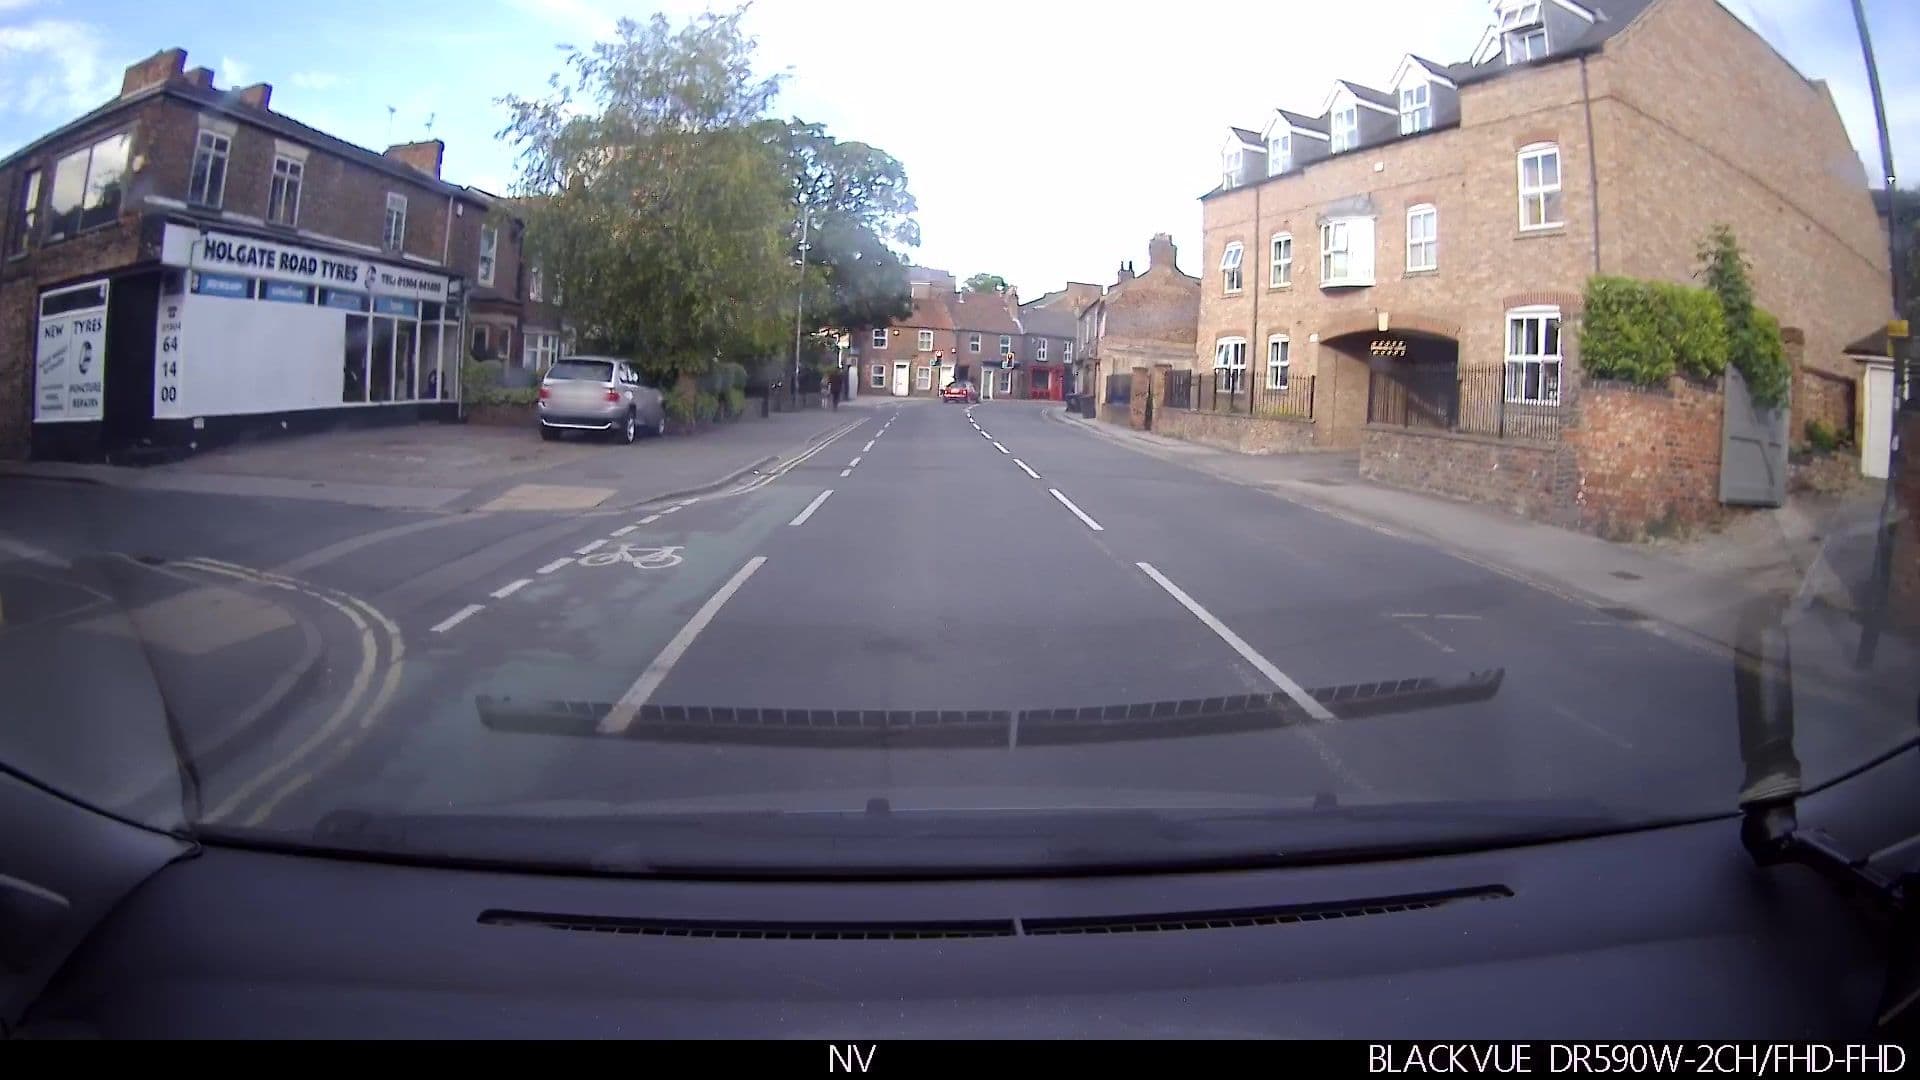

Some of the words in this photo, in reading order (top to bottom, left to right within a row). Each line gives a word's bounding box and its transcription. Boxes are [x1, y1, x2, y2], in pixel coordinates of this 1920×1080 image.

[204, 238, 275, 269] HOLGATE
[279, 253, 317, 275] ROAD
[322, 260, 357, 281] TYRES
[44, 324, 64, 339] NEW
[73, 318, 102, 335] TYRES
[163, 336, 177, 352] 64
[163, 361, 177, 377] 14
[161, 386, 176, 402] 00
